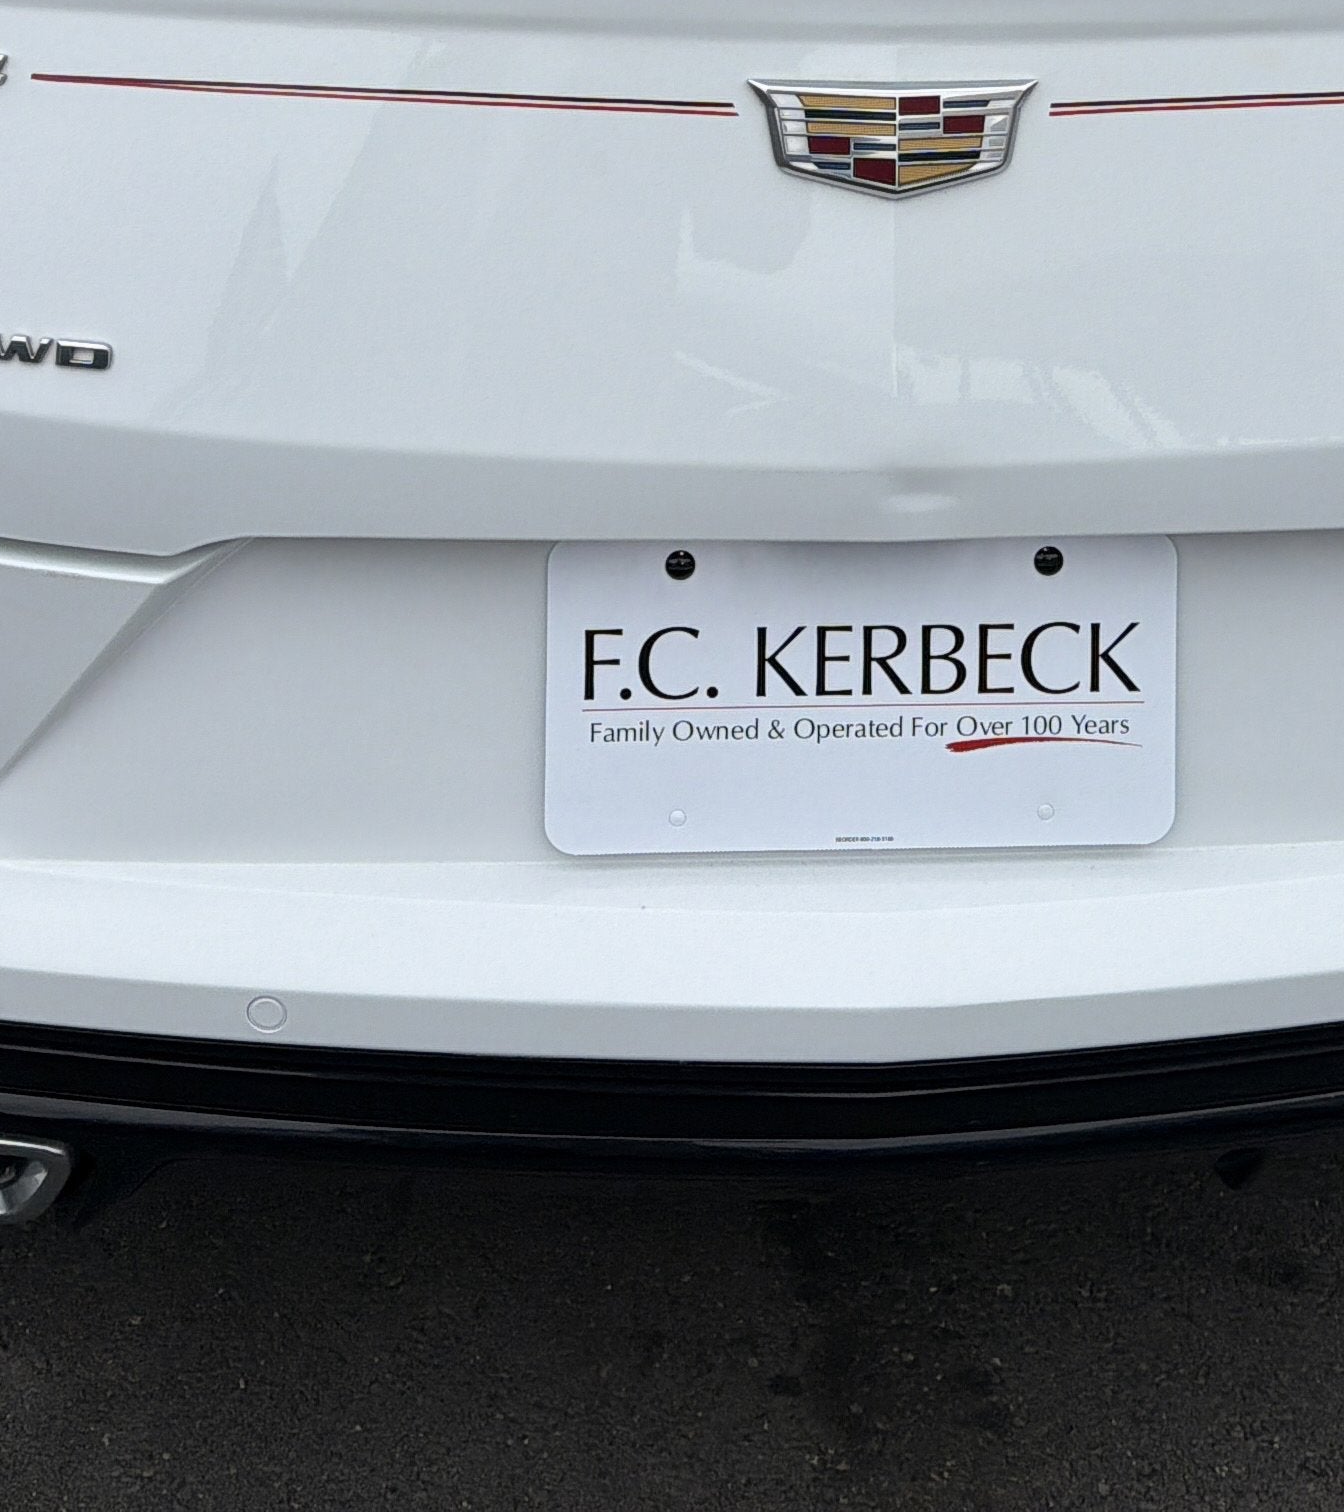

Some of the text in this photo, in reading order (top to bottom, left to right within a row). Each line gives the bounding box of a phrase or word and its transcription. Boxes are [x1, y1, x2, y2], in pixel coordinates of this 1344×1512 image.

[582, 622, 1142, 701] F.C. KERBECK
[590, 714, 1130, 746] Family Owned & Operated For Over 100 Years
